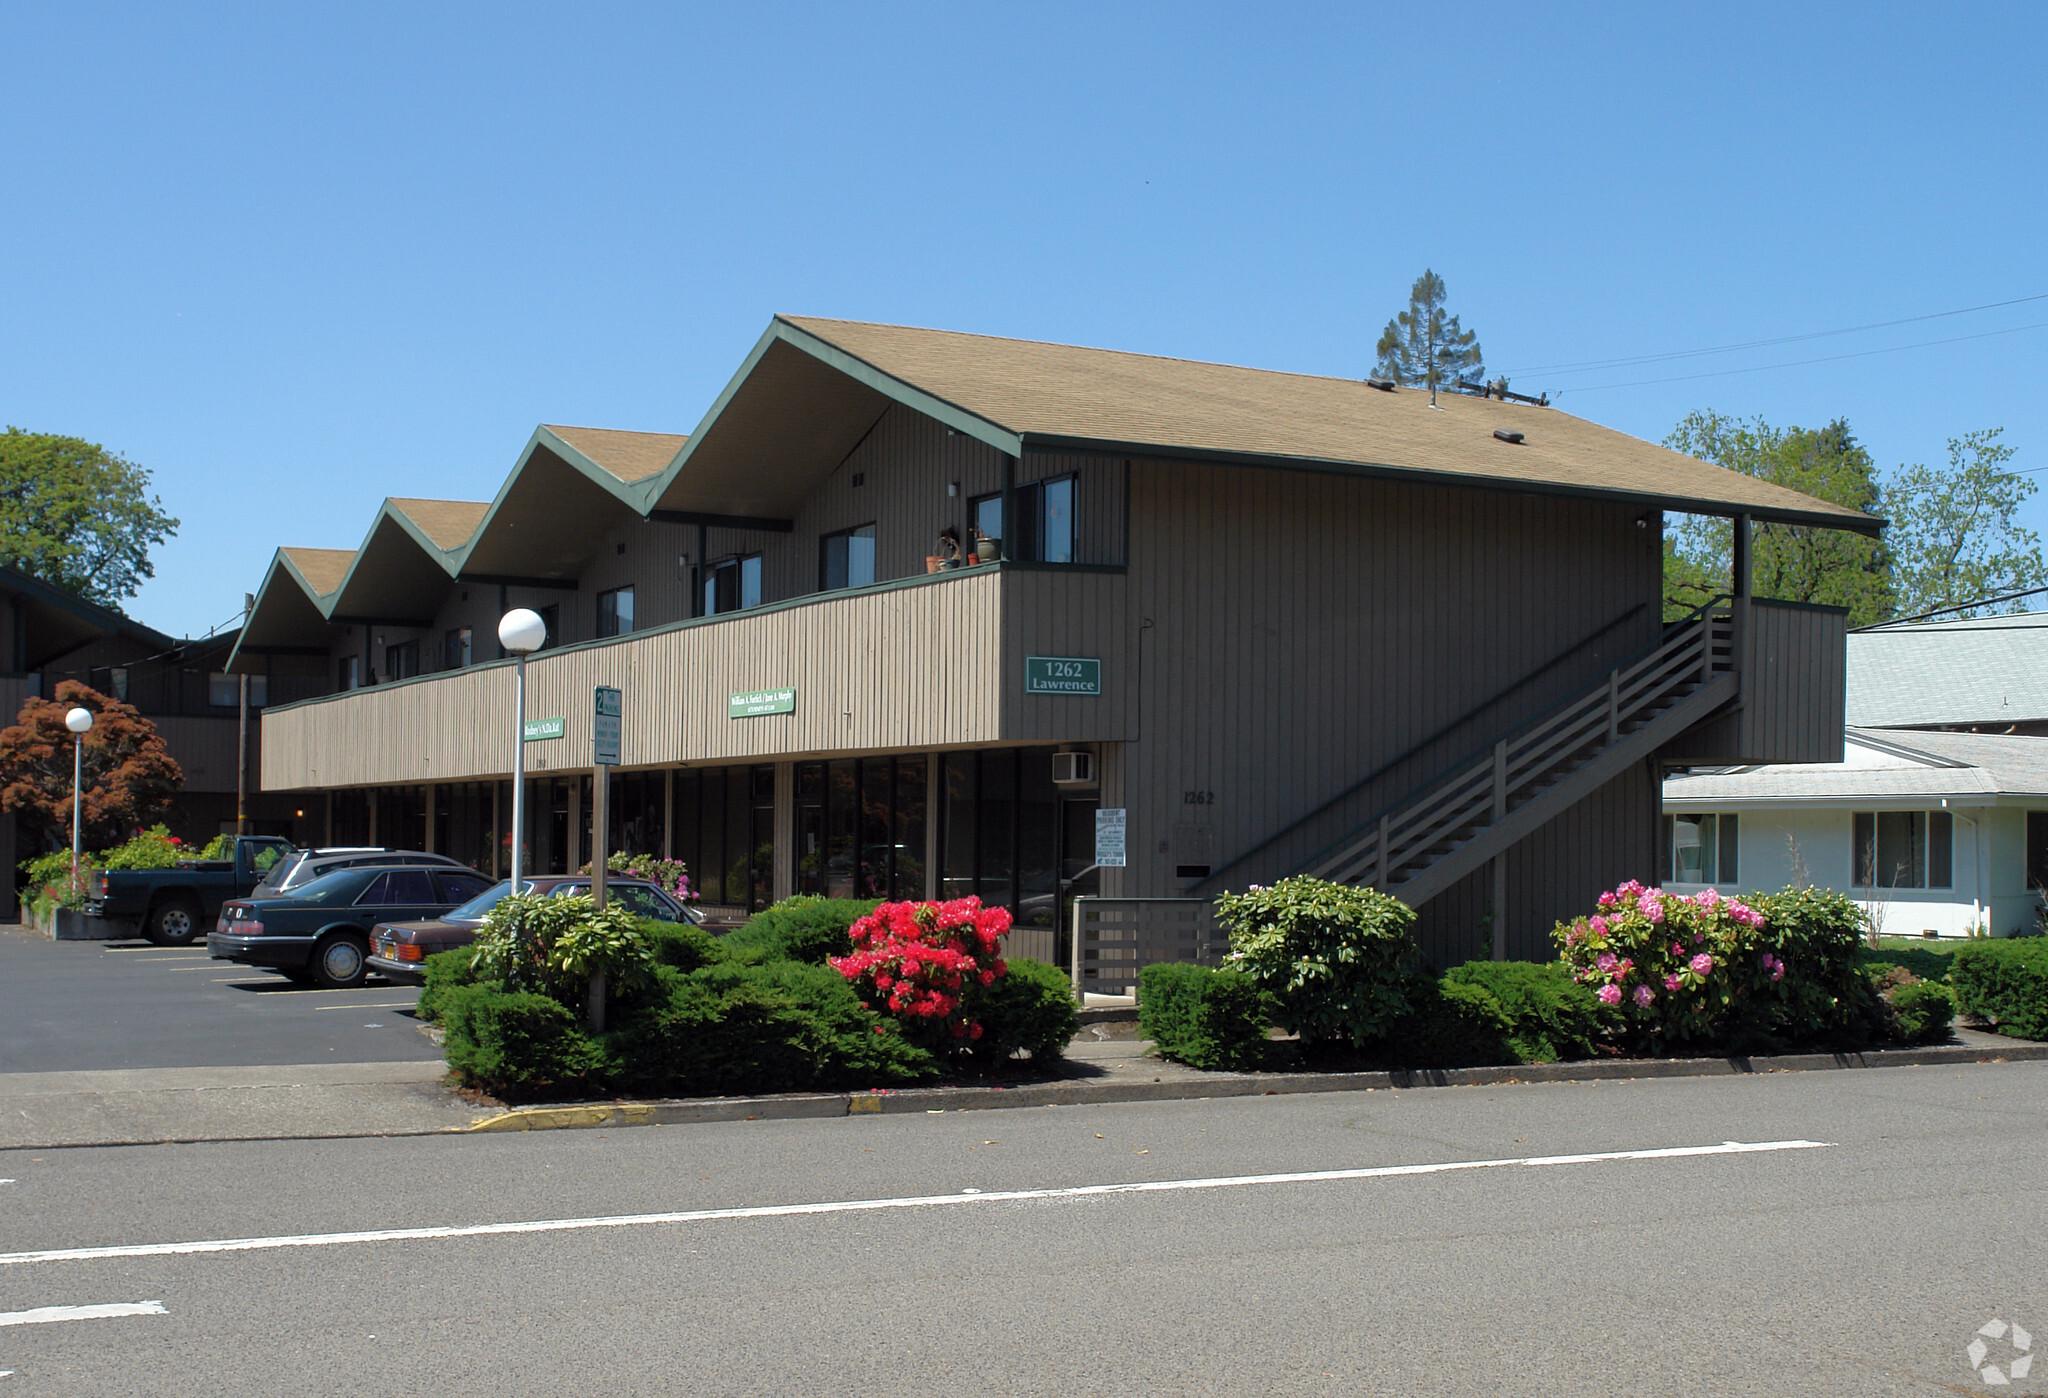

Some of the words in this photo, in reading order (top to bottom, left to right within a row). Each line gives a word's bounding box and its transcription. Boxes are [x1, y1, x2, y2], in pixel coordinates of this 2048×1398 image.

[1045, 662, 1082, 677] 1262
[1033, 677, 1095, 691] Lawrence
[597, 692, 603, 712] 2
[1184, 791, 1214, 805] 1262
